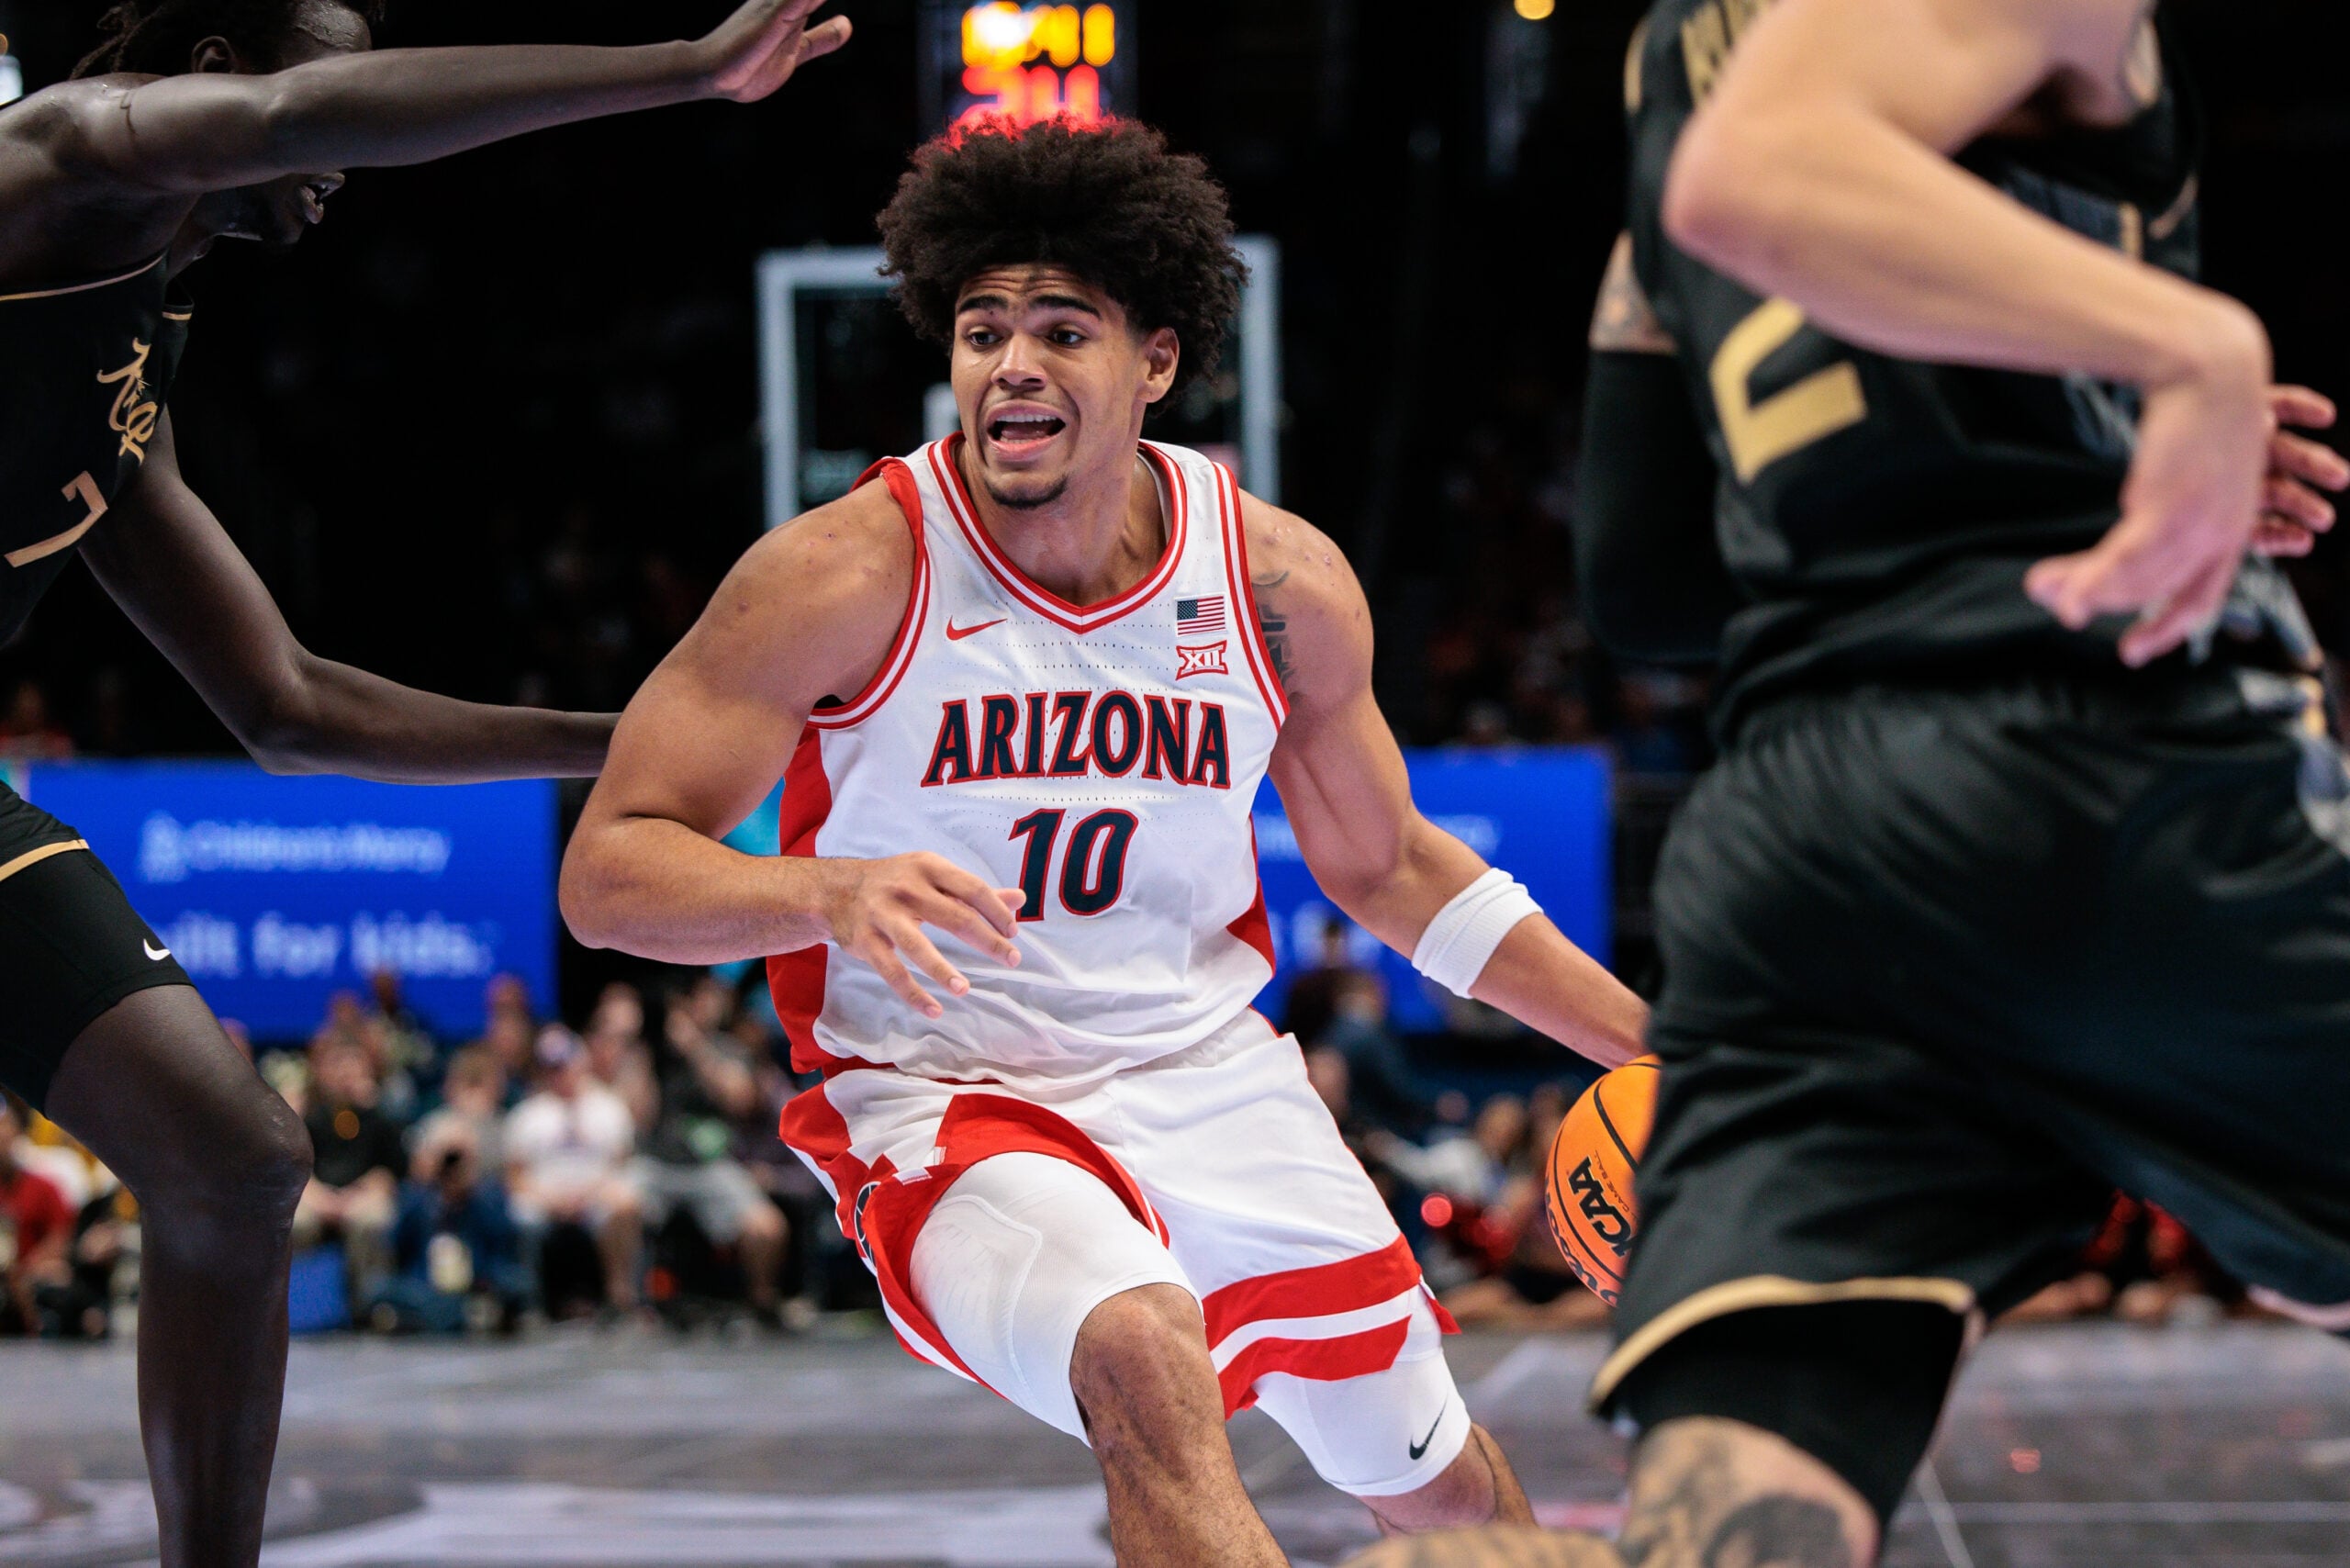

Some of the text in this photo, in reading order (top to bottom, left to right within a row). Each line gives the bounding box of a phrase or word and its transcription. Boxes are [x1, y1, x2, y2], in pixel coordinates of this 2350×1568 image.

[1179, 644, 1226, 677] XII
[921, 689, 1231, 789] ARIZONA
[1008, 808, 1139, 923] 10
